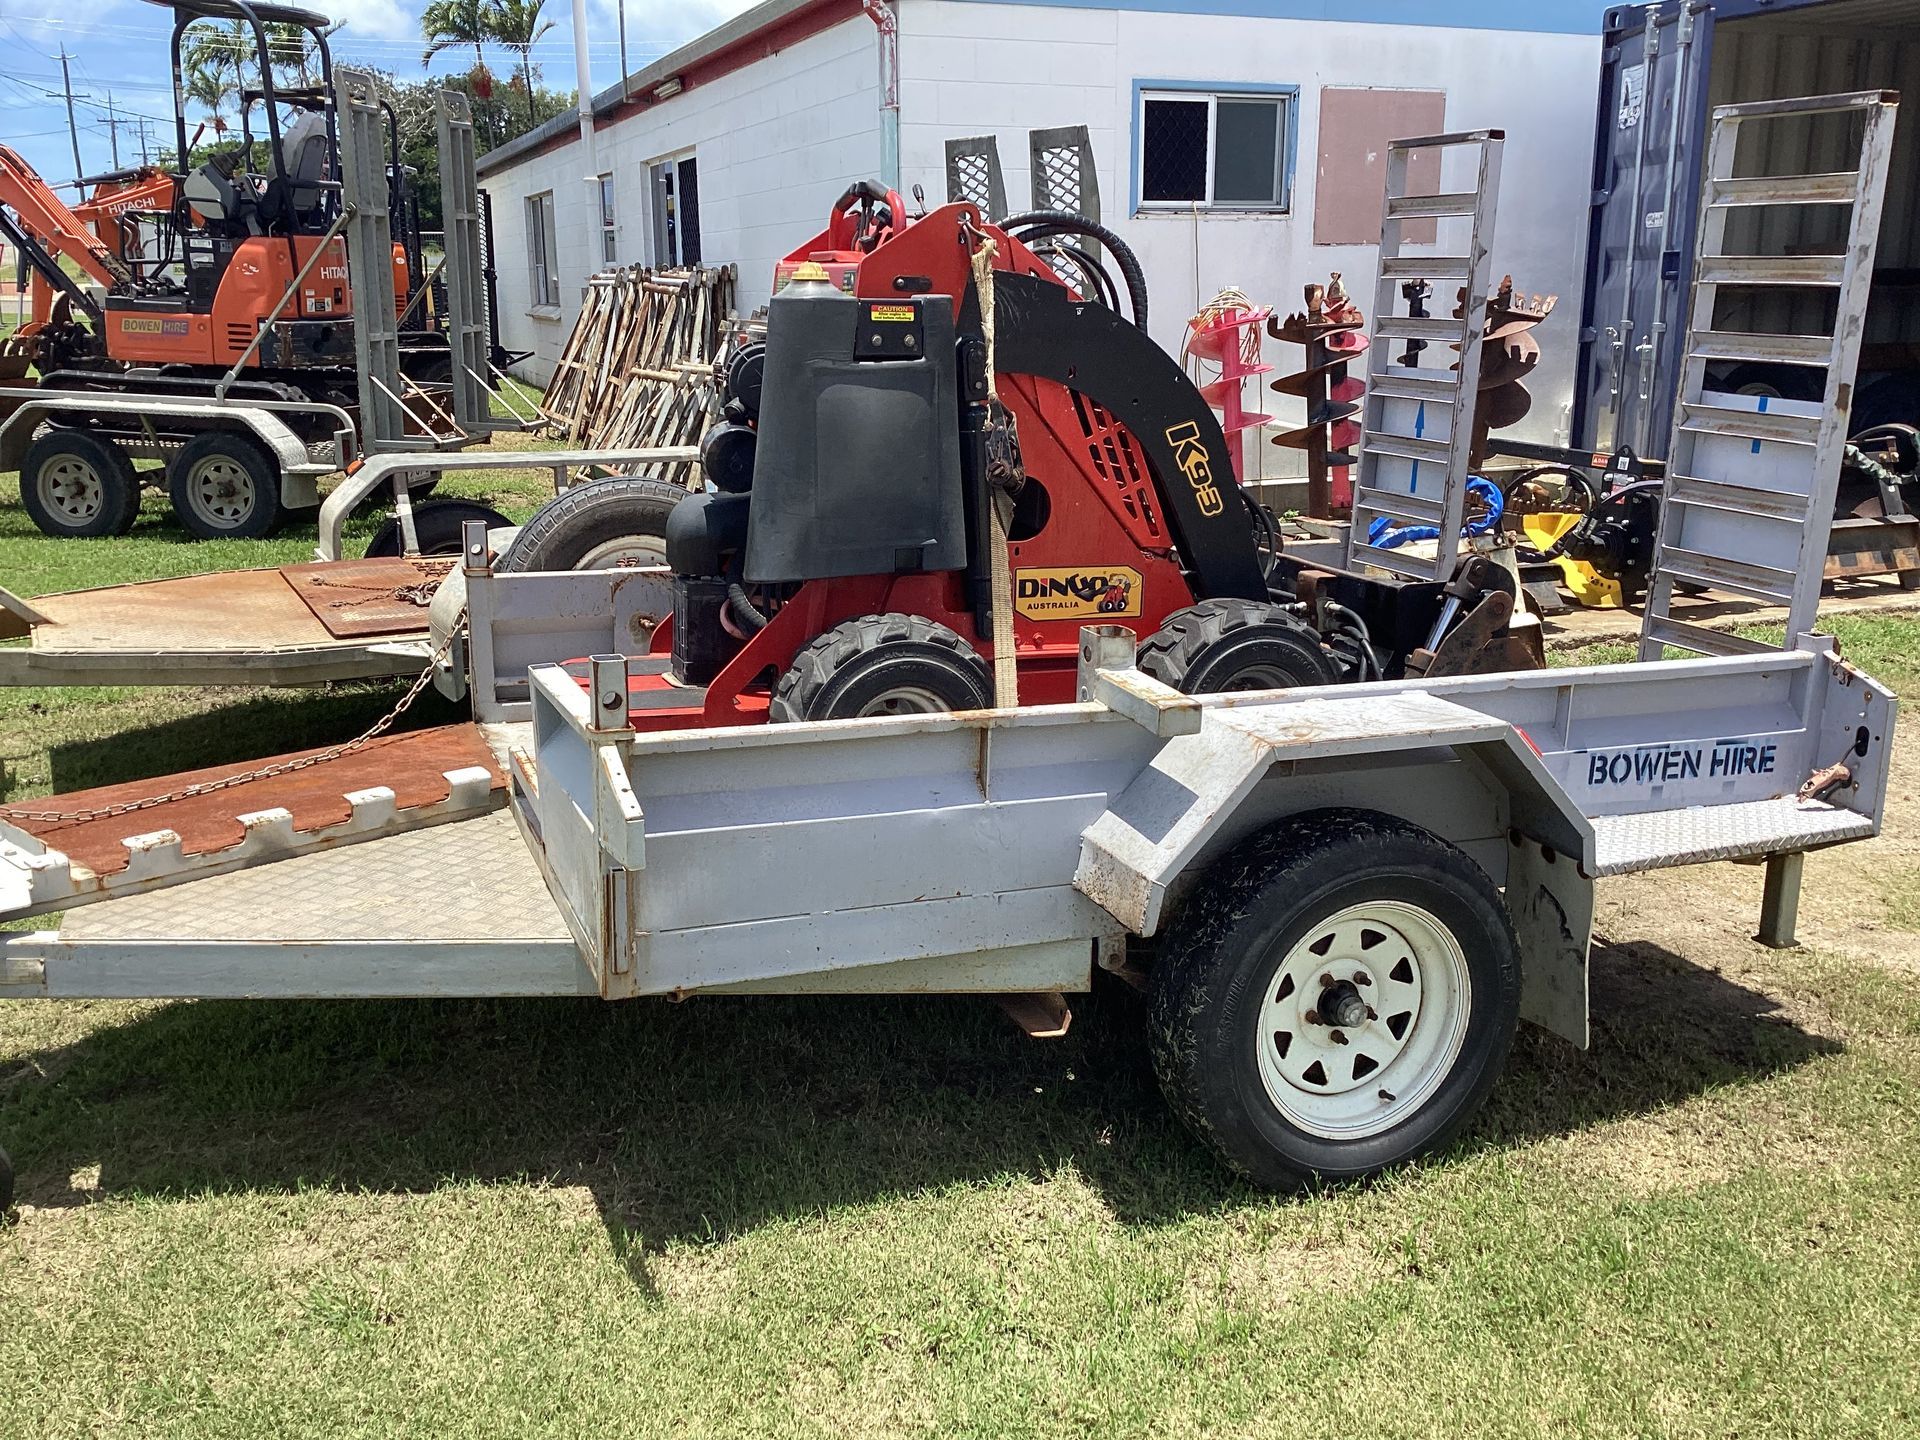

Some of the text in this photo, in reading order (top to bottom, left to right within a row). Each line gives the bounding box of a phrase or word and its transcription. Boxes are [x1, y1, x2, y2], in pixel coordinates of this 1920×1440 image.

[108, 197, 155, 214] HITACHI
[123, 320, 188, 333] BOWEN HIRE
[1027, 601, 1080, 610] AUSTRALIA
[1587, 744, 1777, 785] BOWEN HIRE
